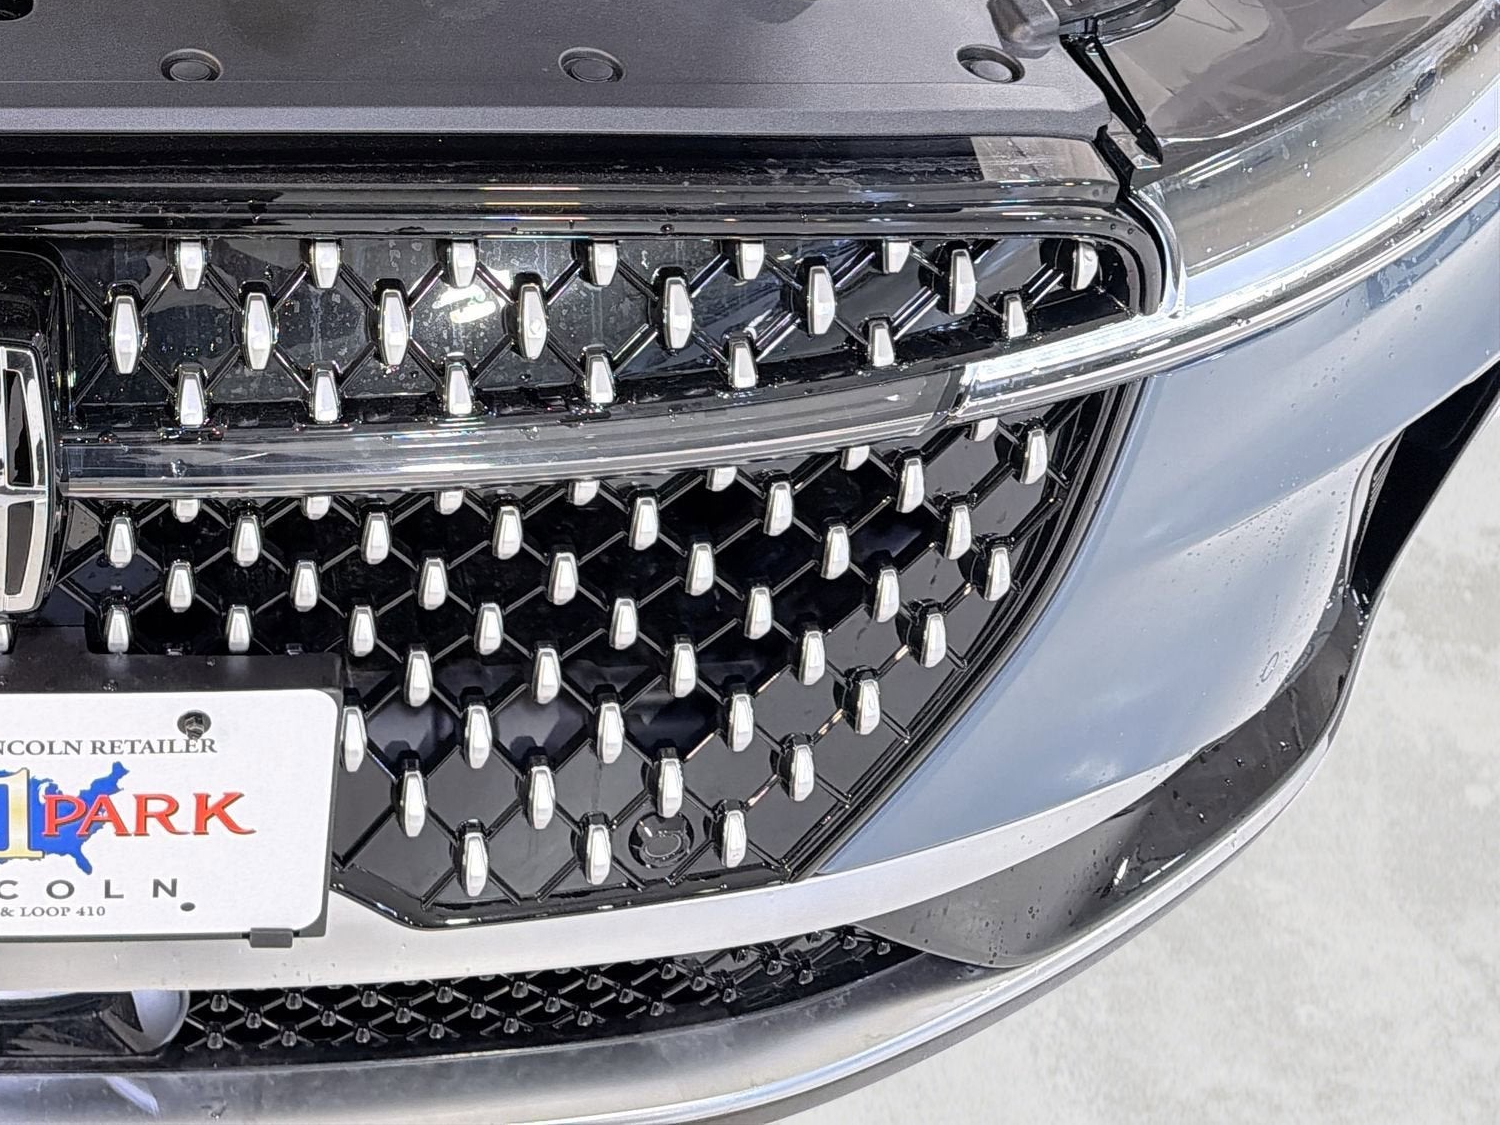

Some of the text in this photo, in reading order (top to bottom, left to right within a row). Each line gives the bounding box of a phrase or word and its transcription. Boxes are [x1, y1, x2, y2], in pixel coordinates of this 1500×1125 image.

[88, 738, 218, 755] RETAILER
[43, 791, 257, 838] PARK
[0, 907, 15, 918] &
[19, 906, 71, 918] LOOP
[76, 906, 106, 917] 410
